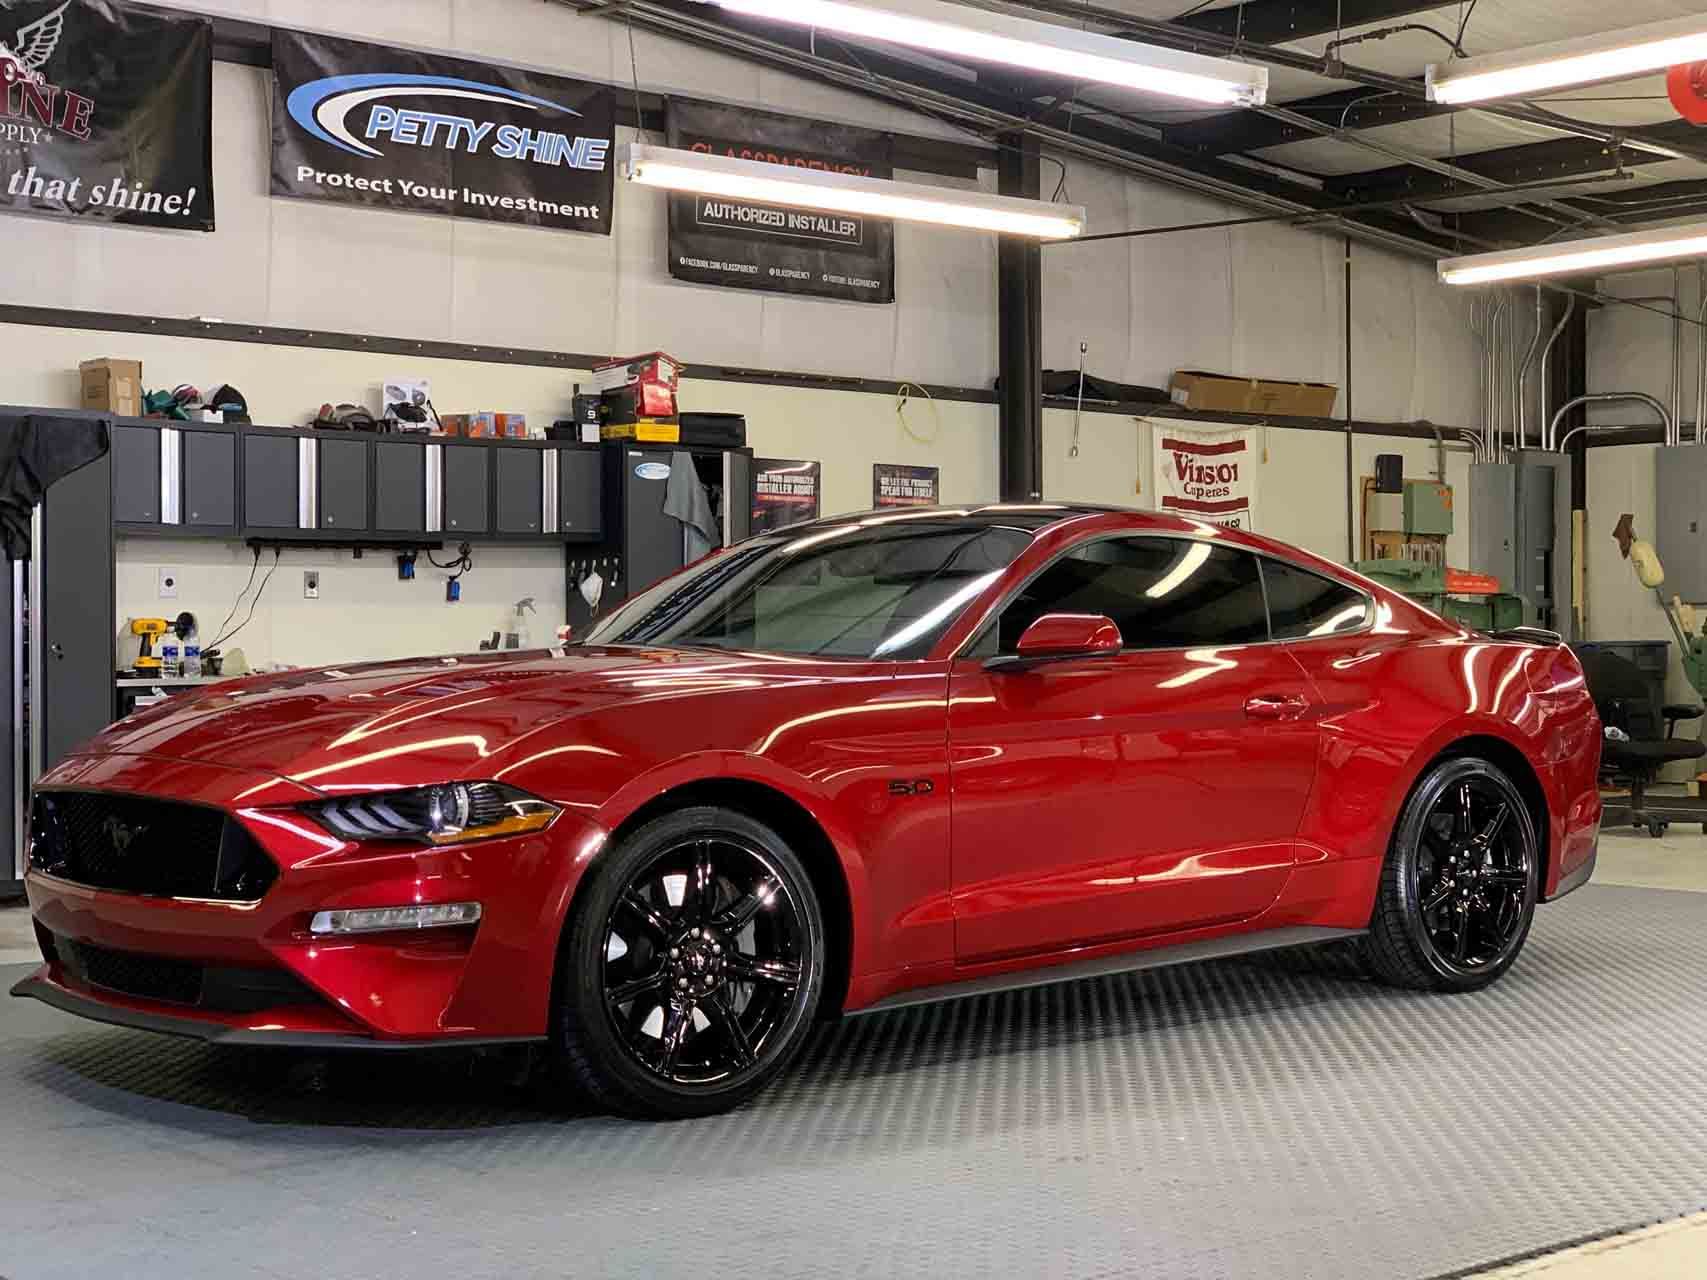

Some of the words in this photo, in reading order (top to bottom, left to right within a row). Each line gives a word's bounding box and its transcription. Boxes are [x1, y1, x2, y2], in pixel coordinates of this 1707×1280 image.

[365, 104, 497, 153] PETTY
[491, 124, 609, 171] SHINE
[7, 166, 82, 202] that
[88, 177, 197, 216] shine!
[297, 165, 393, 194] Protect
[398, 178, 458, 201] Your
[463, 187, 600, 219] Investment
[703, 201, 785, 227] AUTHORIZED
[788, 213, 857, 237] INSTALLER
